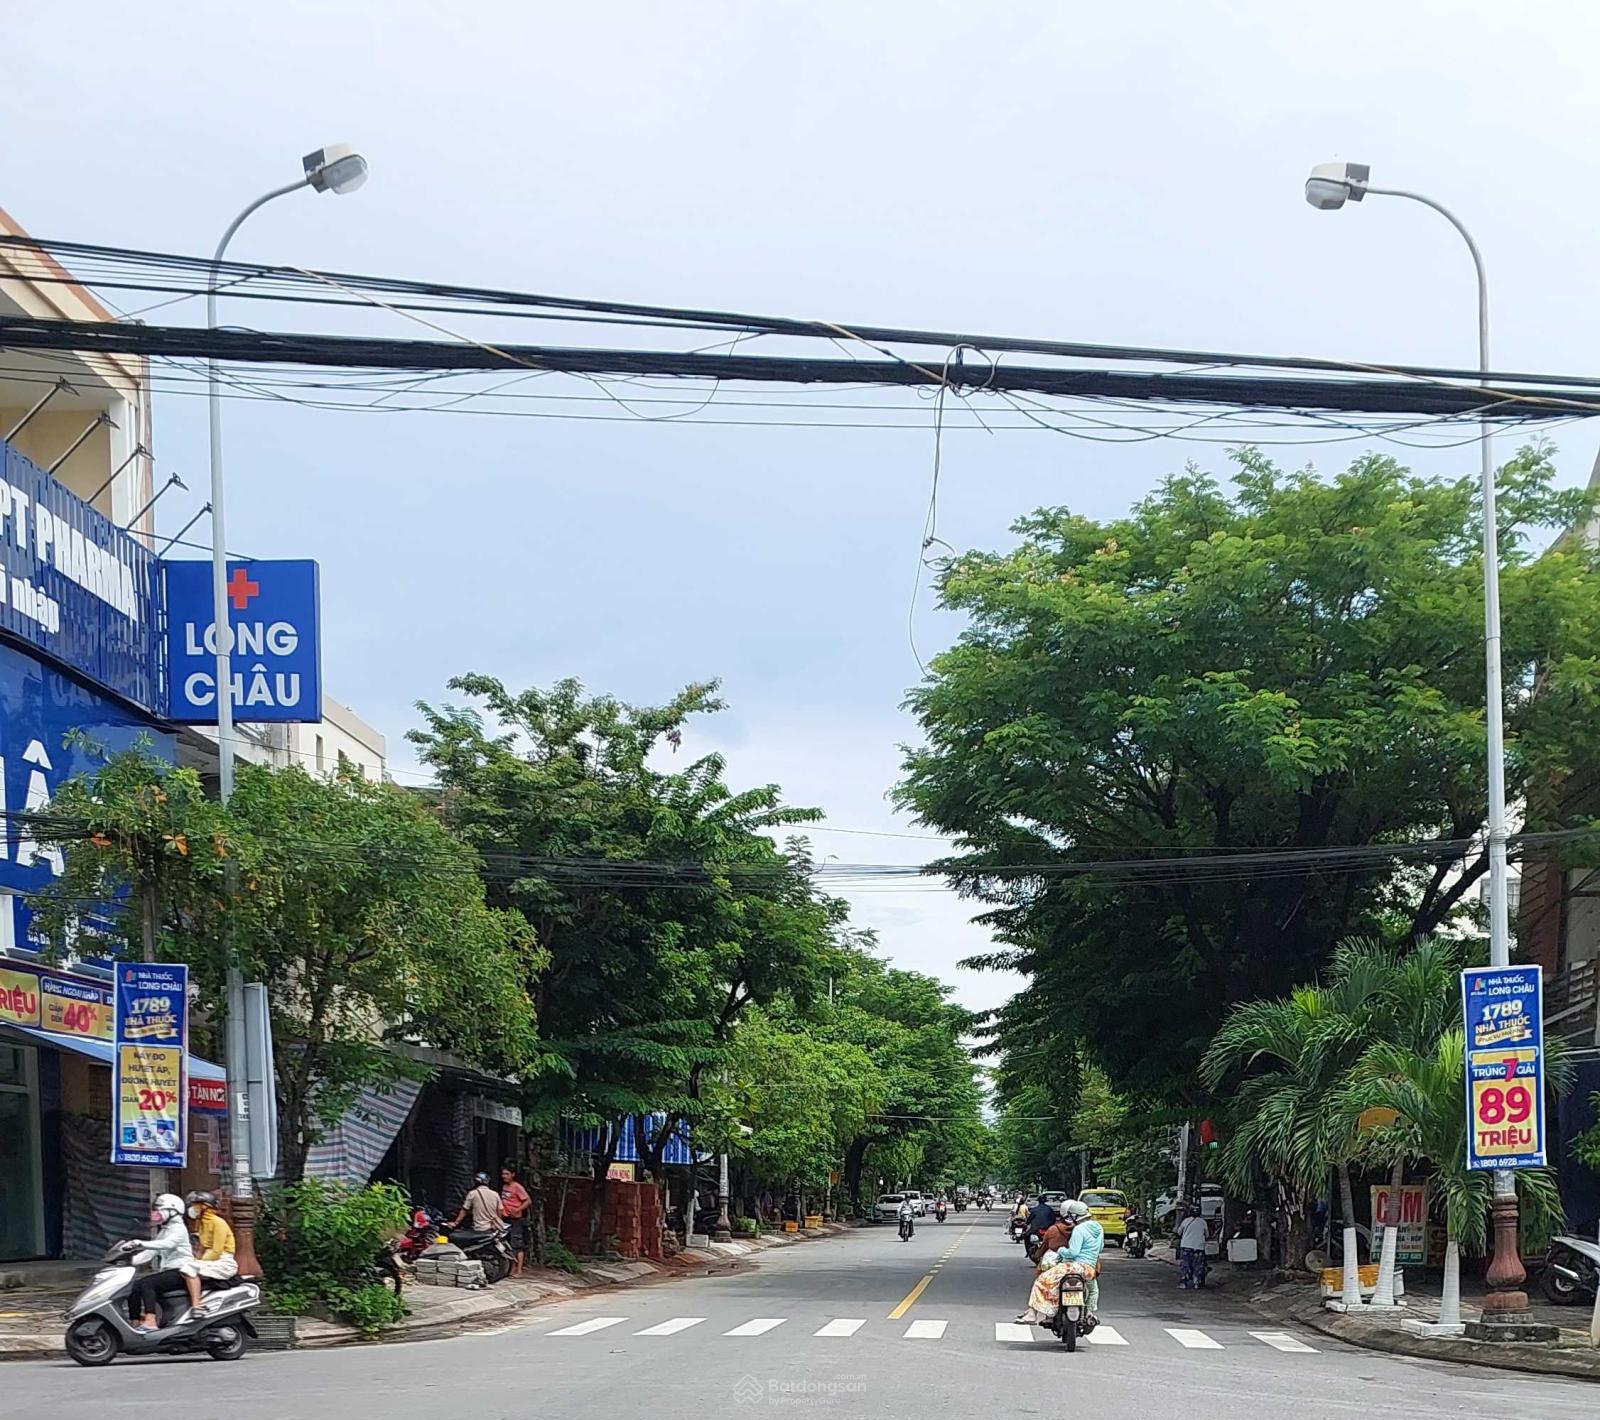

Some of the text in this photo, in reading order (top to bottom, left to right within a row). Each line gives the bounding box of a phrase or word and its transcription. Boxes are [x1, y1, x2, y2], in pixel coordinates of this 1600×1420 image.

[36, 502, 137, 624] PHARMA
[12, 577, 59, 634] nhập
[186, 622, 298, 656] LONG
[185, 664, 300, 706] CHÂU
[138, 982, 160, 990] LONG
[1488, 975, 1524, 985] NHÀ THUỐC
[1488, 986, 1511, 996] LONG
[1513, 983, 1535, 994] CHÂU
[131, 996, 171, 1014] 1789
[1482, 1000, 1523, 1021] 1789
[146, 1011, 177, 1024] THUỐC
[1475, 1019, 1496, 1034] NHÀ
[1498, 1013, 1530, 1029] THUỐC
[1472, 1058, 1535, 1082] TRÚNG 7 GIẢI
[139, 1089, 177, 1111] 20%
[1479, 1086, 1532, 1124] 89
[1478, 1125, 1532, 1149] TRIỆU
[1480, 1159, 1498, 1168] 1800
[1499, 1158, 1518, 1166] 6928
[1376, 1191, 1422, 1223] CM
